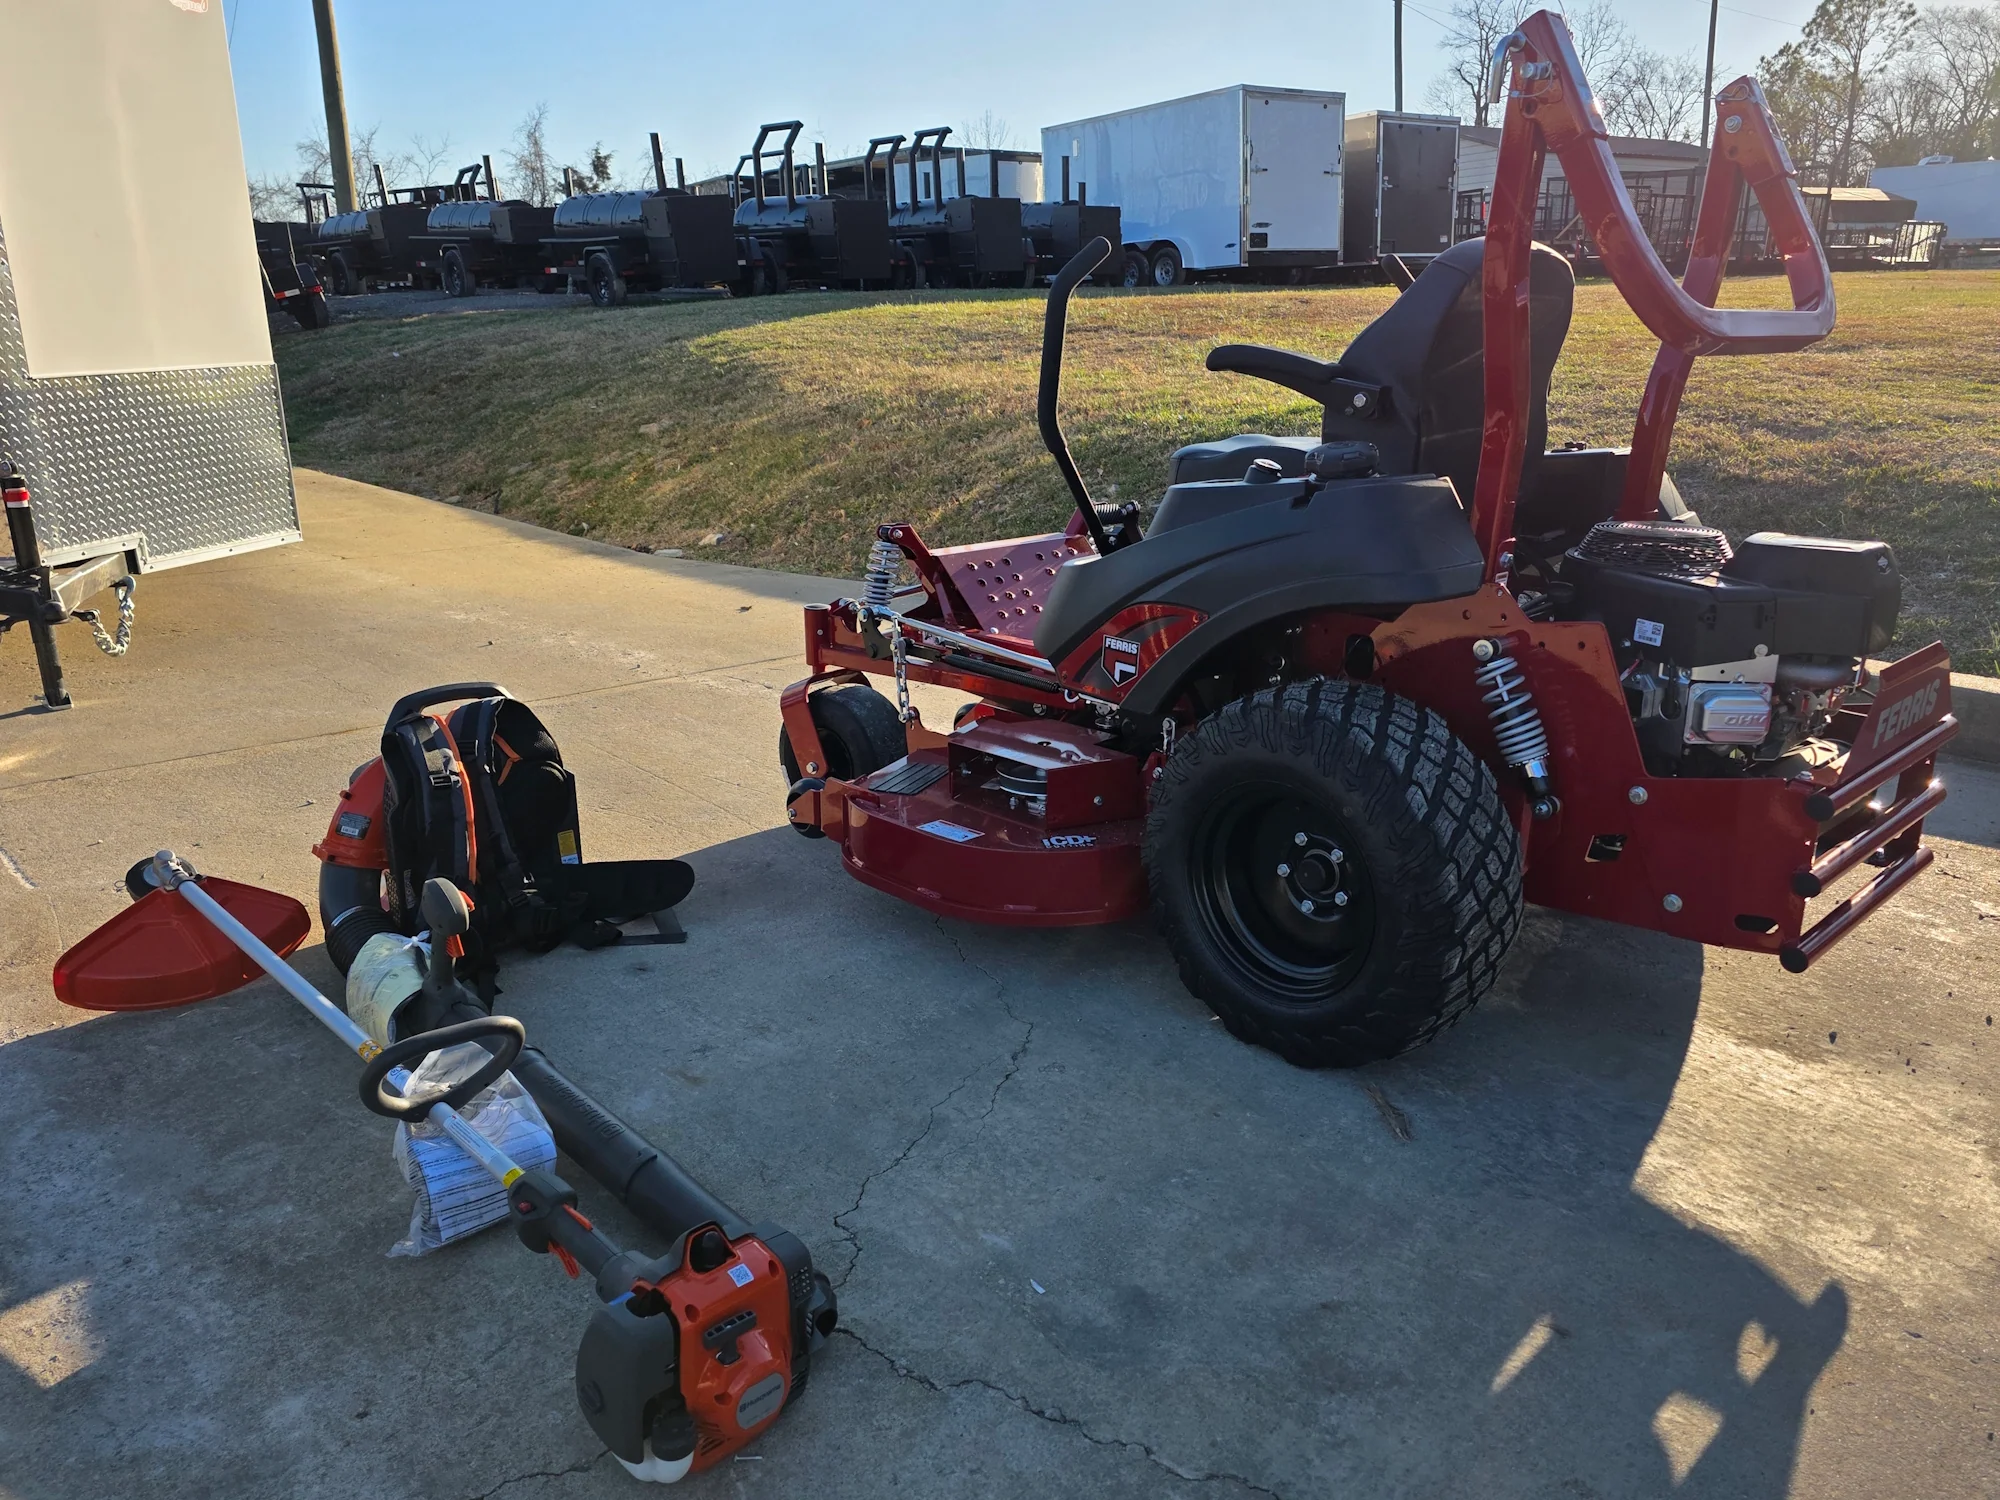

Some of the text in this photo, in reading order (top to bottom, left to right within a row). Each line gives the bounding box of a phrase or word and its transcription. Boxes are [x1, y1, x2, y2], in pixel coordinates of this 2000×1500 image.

[1105, 637, 1138, 655] FERRIS
[1872, 678, 1941, 749] FERRIS
[544, 1074, 612, 1133] Husqvarna
